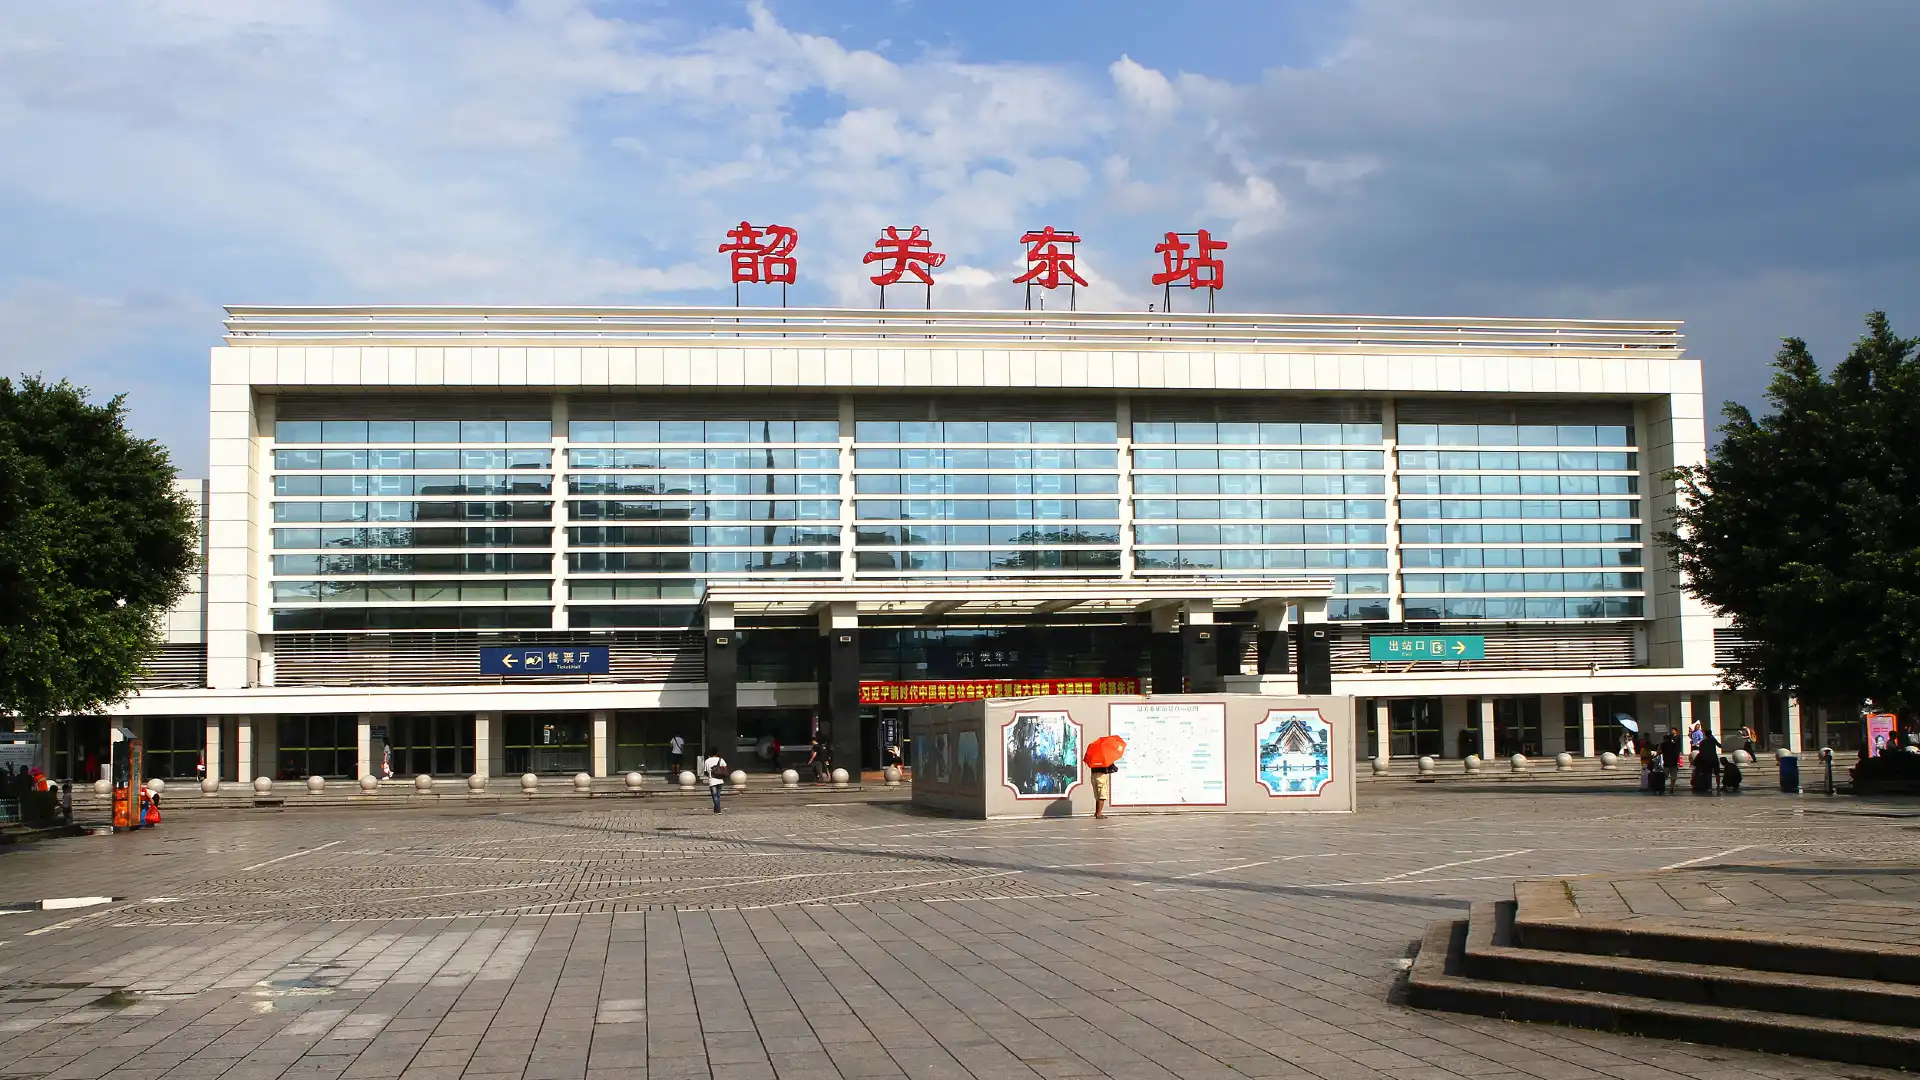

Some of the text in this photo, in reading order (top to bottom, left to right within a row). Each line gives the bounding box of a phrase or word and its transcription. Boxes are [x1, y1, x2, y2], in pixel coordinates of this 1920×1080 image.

[718, 220, 1228, 290] 韶关东站
[1389, 640, 1425, 651] 出站口
[547, 651, 590, 664] 售票厅
[860, 683, 1050, 701] 习近平新时代中国特色社会主义思想伟大旗帜
